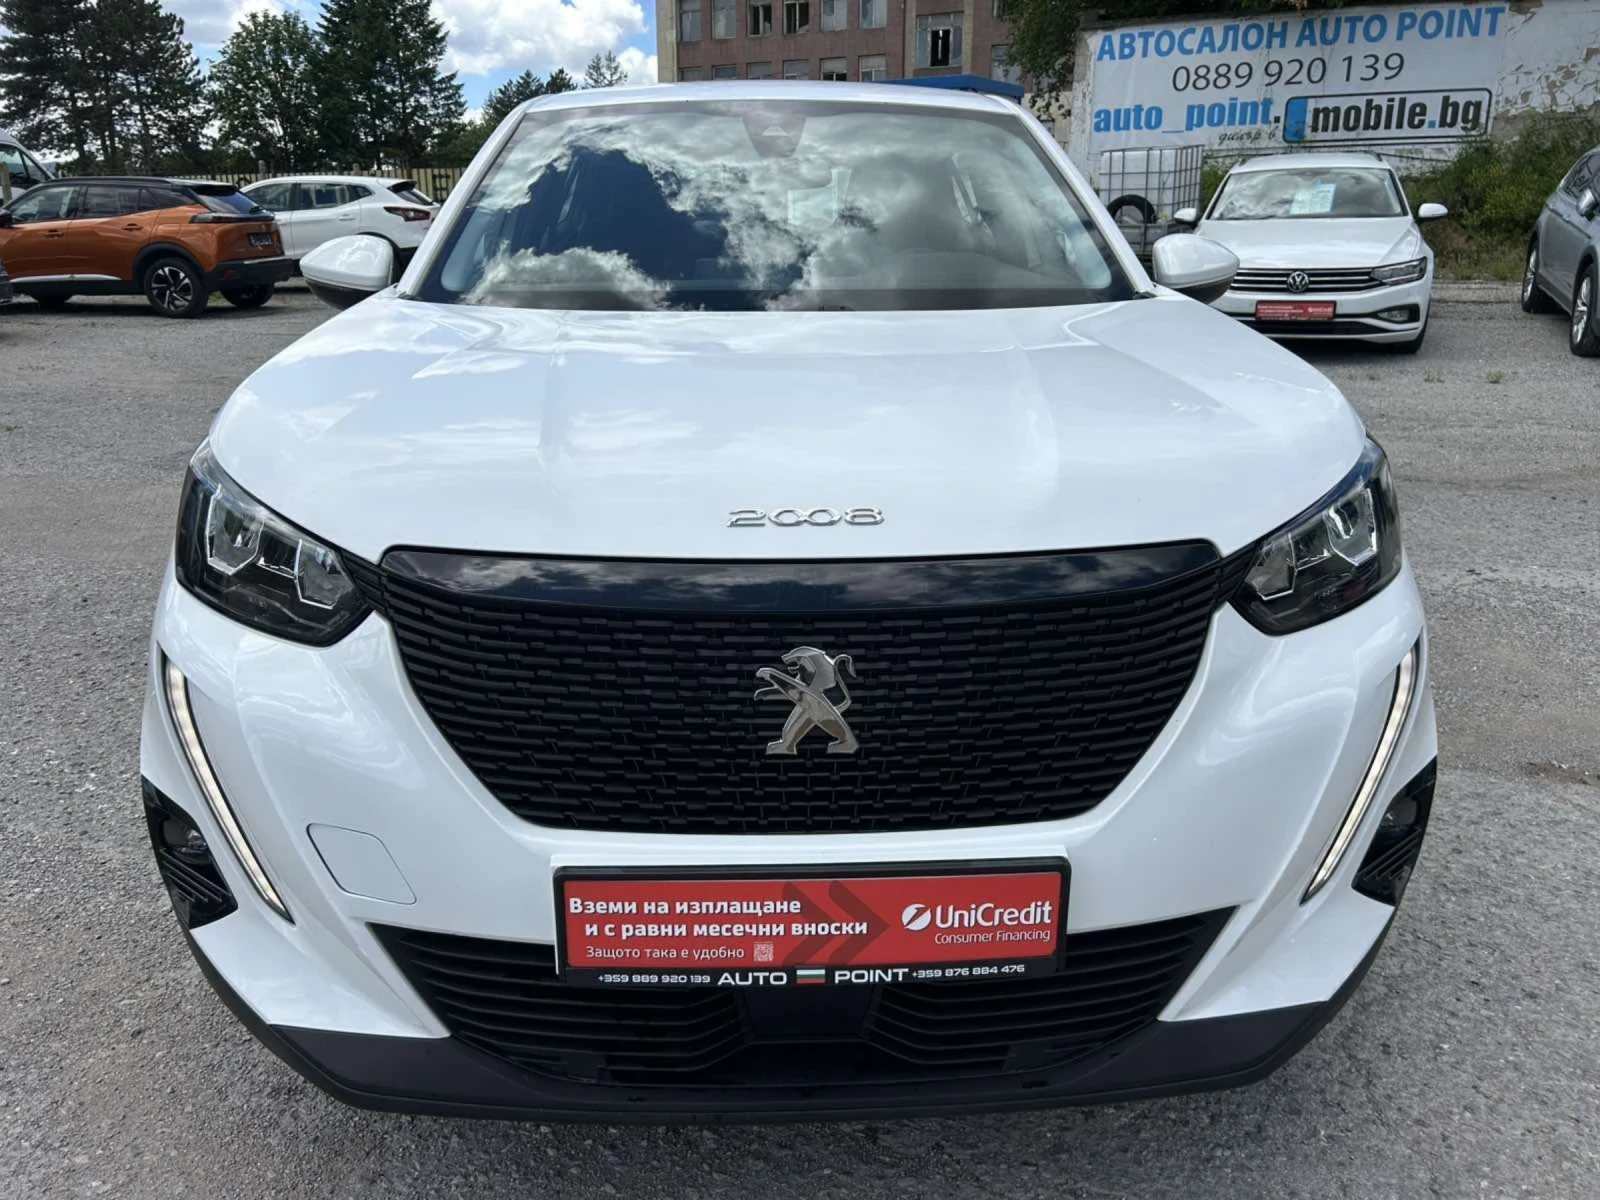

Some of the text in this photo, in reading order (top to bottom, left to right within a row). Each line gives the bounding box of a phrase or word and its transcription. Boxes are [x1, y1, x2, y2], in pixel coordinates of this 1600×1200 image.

[1096, 6, 1506, 62] АВТОСАЛОН AUTO POINT
[1172, 52, 1405, 92] 0889 920 139
[1311, 95, 1483, 133] mobile.bg
[727, 507, 885, 528] 2008
[569, 898, 802, 917] Вземи на изплащане
[935, 901, 1053, 929] UniCredit
[585, 921, 868, 940] и с равни месечни вноски
[934, 929, 1051, 945] Consumer Financing
[586, 946, 745, 960] Защото така е удобно
[597, 965, 1025, 986] +359 889 920 139 AUTO POINT +359 876 884 476
